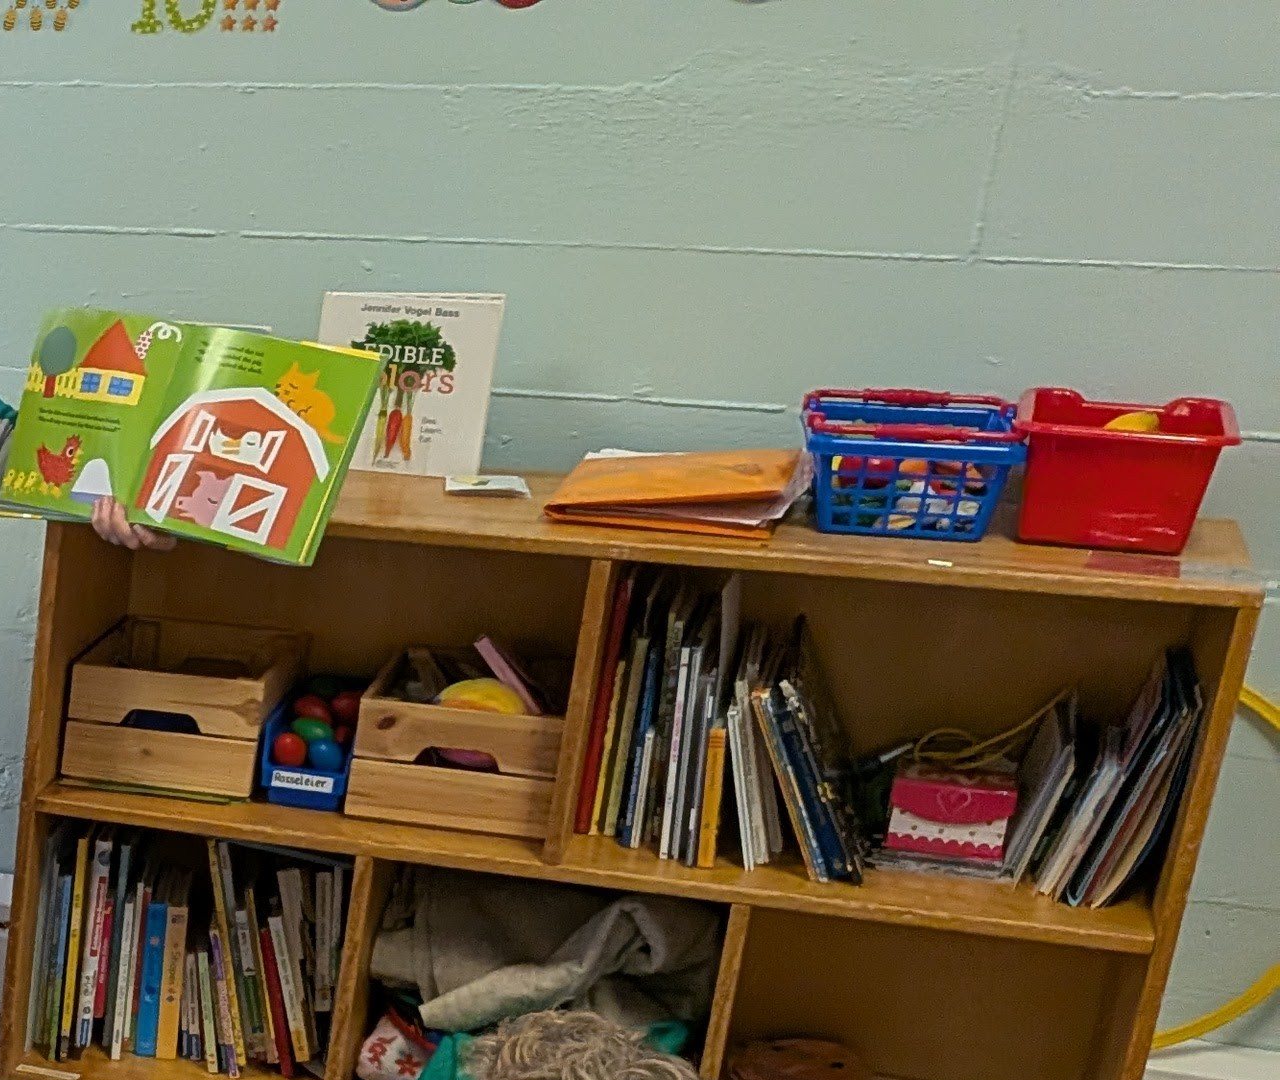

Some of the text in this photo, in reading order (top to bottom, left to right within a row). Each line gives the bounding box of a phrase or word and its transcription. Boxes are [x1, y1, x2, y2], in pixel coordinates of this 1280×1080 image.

[361, 303, 460, 318] Jennifer Vogel Bass
